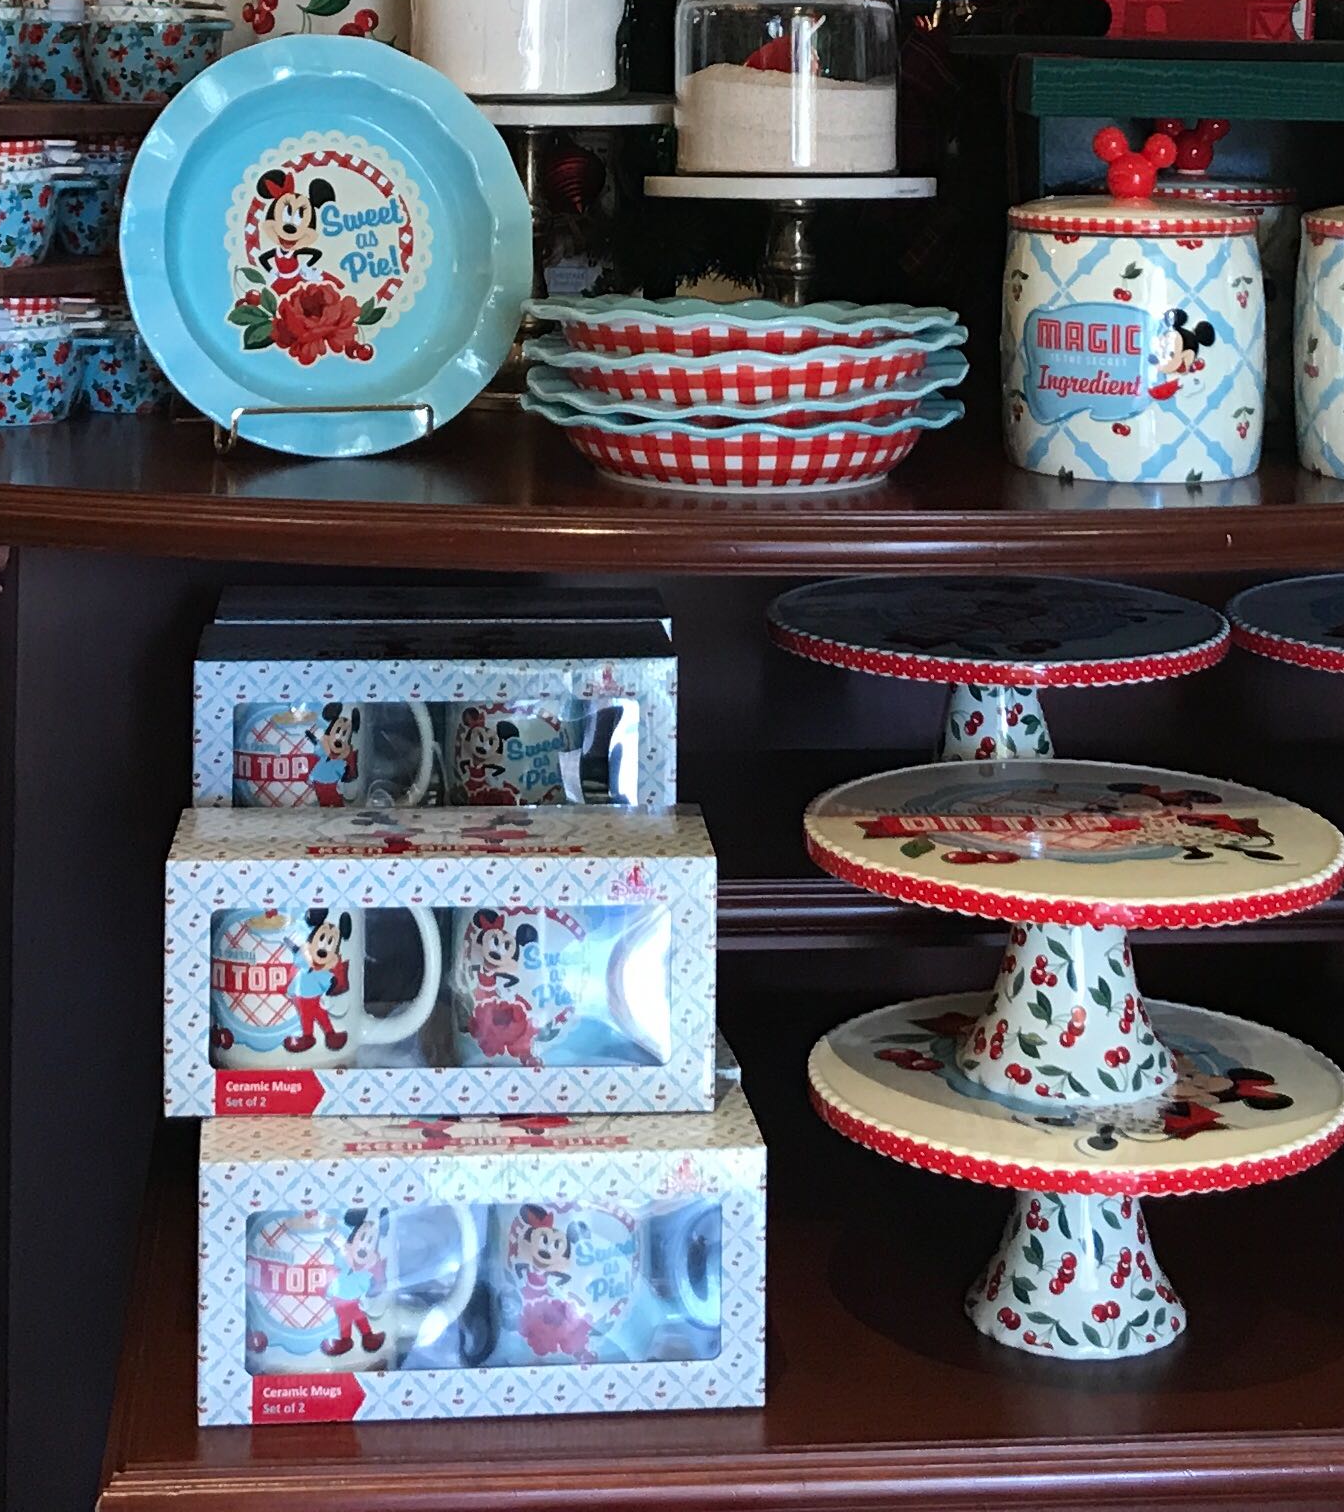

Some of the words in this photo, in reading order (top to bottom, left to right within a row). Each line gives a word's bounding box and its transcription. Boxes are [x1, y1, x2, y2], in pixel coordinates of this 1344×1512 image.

[320, 197, 404, 237] Sweet
[355, 230, 379, 250] as
[339, 244, 402, 284] Pie!
[1036, 317, 1142, 355] MAGIC
[1037, 364, 1142, 398] Ingredient
[257, 756, 308, 780] TOP
[990, 814, 1112, 832] TOP
[232, 964, 288, 992] TOP
[225, 1080, 270, 1092] Ceramic
[271, 1080, 302, 1095] Mugs
[225, 1096, 243, 1107] Set
[246, 1096, 258, 1107] of
[259, 1096, 267, 1107] 2
[267, 1265, 328, 1293] TOP
[262, 1386, 308, 1399] Ceramic
[310, 1385, 342, 1399] Mugs
[262, 1403, 281, 1415] Set
[283, 1402, 296, 1414] of
[298, 1402, 306, 1414] 2
